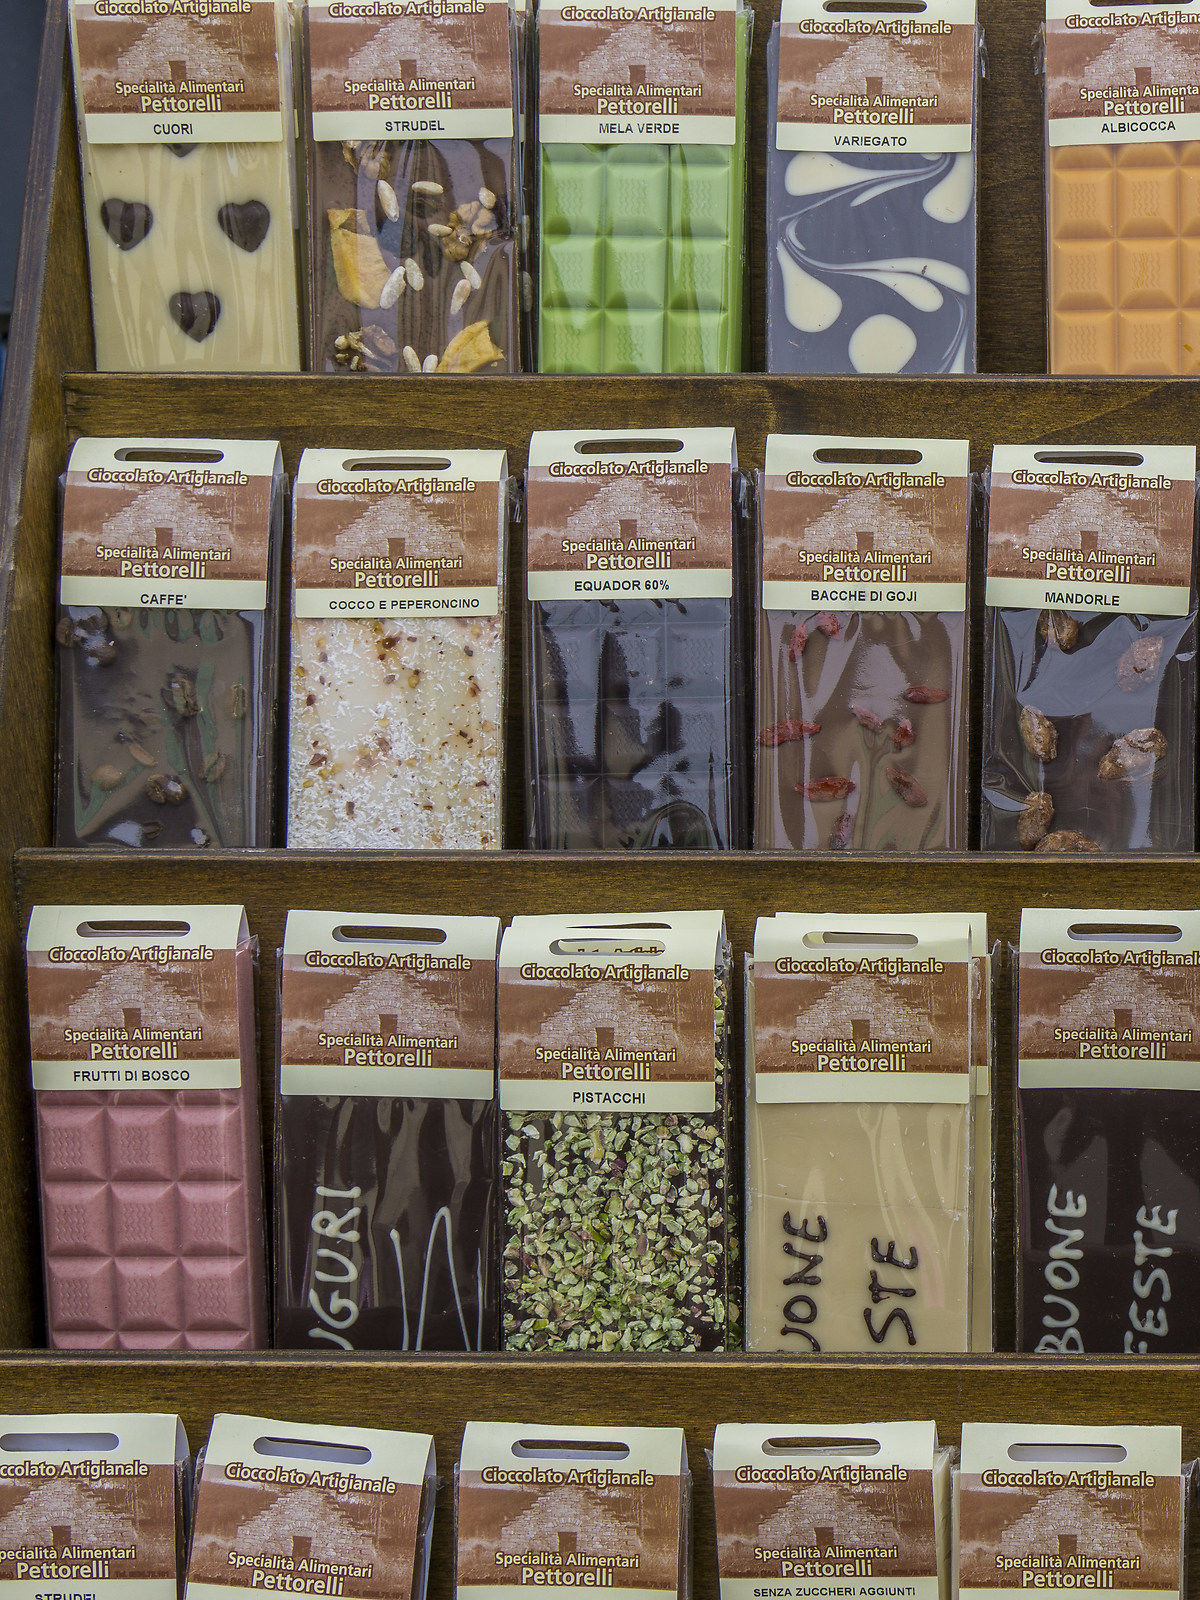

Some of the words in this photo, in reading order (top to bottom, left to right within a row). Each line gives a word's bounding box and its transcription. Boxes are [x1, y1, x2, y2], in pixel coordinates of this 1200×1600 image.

[561, 6, 634, 21] Cioccolato
[637, 6, 716, 23] Artigianale
[1066, 12, 1138, 29] Cioccolato
[574, 84, 633, 97] Specialità
[636, 84, 702, 96] Alimentari
[1080, 86, 1139, 101] Specialità
[596, 98, 678, 114] Pettorelli
[1103, 97, 1185, 116] Pettorelli
[153, 123, 193, 135] CUORI
[385, 120, 445, 132] STRUDEL
[599, 123, 634, 134] MELA
[638, 123, 680, 134] VERDE
[1101, 120, 1176, 134] ALBICOCCA
[833, 135, 908, 147] VARIEGATO
[549, 460, 624, 477] Cioccolato
[627, 459, 709, 477] Artigianale
[87, 467, 163, 483] Cioccolato
[166, 469, 249, 487] Artigianale
[1012, 469, 1088, 486] Cioccolato
[1090, 472, 1172, 492] Artigianale
[96, 546, 159, 560] Specialità
[161, 547, 231, 560] Alimentari
[562, 539, 624, 554] Specialità
[626, 538, 696, 551] Alimentari
[586, 552, 671, 570] Pettorelli
[1022, 547, 1084, 564] Specialità
[1086, 551, 1156, 565] Alimentari
[119, 560, 206, 578] Pettorelli
[1045, 562, 1131, 583] Pettorelli
[574, 579, 642, 592] EQUADOR
[644, 579, 670, 591] 60%
[811, 589, 866, 602] BACCHE
[870, 590, 883, 602] DI
[885, 590, 917, 602] GOJI
[1044, 591, 1120, 607] MANDORLE
[329, 600, 375, 610] COCCO
[379, 600, 387, 610] E
[390, 598, 480, 610] PEPERONCINO
[305, 951, 384, 968] Cioccolato
[387, 953, 472, 972] Artigianale
[775, 957, 855, 973] Cioccolato
[858, 958, 945, 975] Artigianale
[318, 1033, 383, 1048] Specialità
[386, 1035, 458, 1048] Alimentari
[791, 1040, 856, 1054] Specialità
[859, 1040, 931, 1052] Alimentari
[344, 1048, 433, 1066] Pettorelli
[817, 1054, 906, 1071] Pettorelli
[73, 1070, 121, 1082] FRUTTI
[124, 1070, 138, 1082] DI
[141, 1069, 190, 1082] BOSCO
[572, 1091, 646, 1105] PISTACCHI
[1034, 1183, 1087, 1353] BUONE
[224, 1462, 307, 1486] Cioccolato
[308, 1470, 398, 1497] Artigianale
[734, 1466, 817, 1482] Cioccolato
[819, 1465, 909, 1484] Artigianale
[754, 1546, 821, 1561] Specialità
[823, 1546, 897, 1558] Alimentari
[227, 1551, 295, 1572] Specialità
[297, 1558, 372, 1578] Alimentari
[781, 1560, 872, 1577] Pettorelli
[251, 1569, 344, 1596] Pettorelli
[753, 1587, 793, 1598] SENZA
[795, 1587, 856, 1597] ZUCCHERI
[858, 1586, 916, 1597] AGGIUNTI
